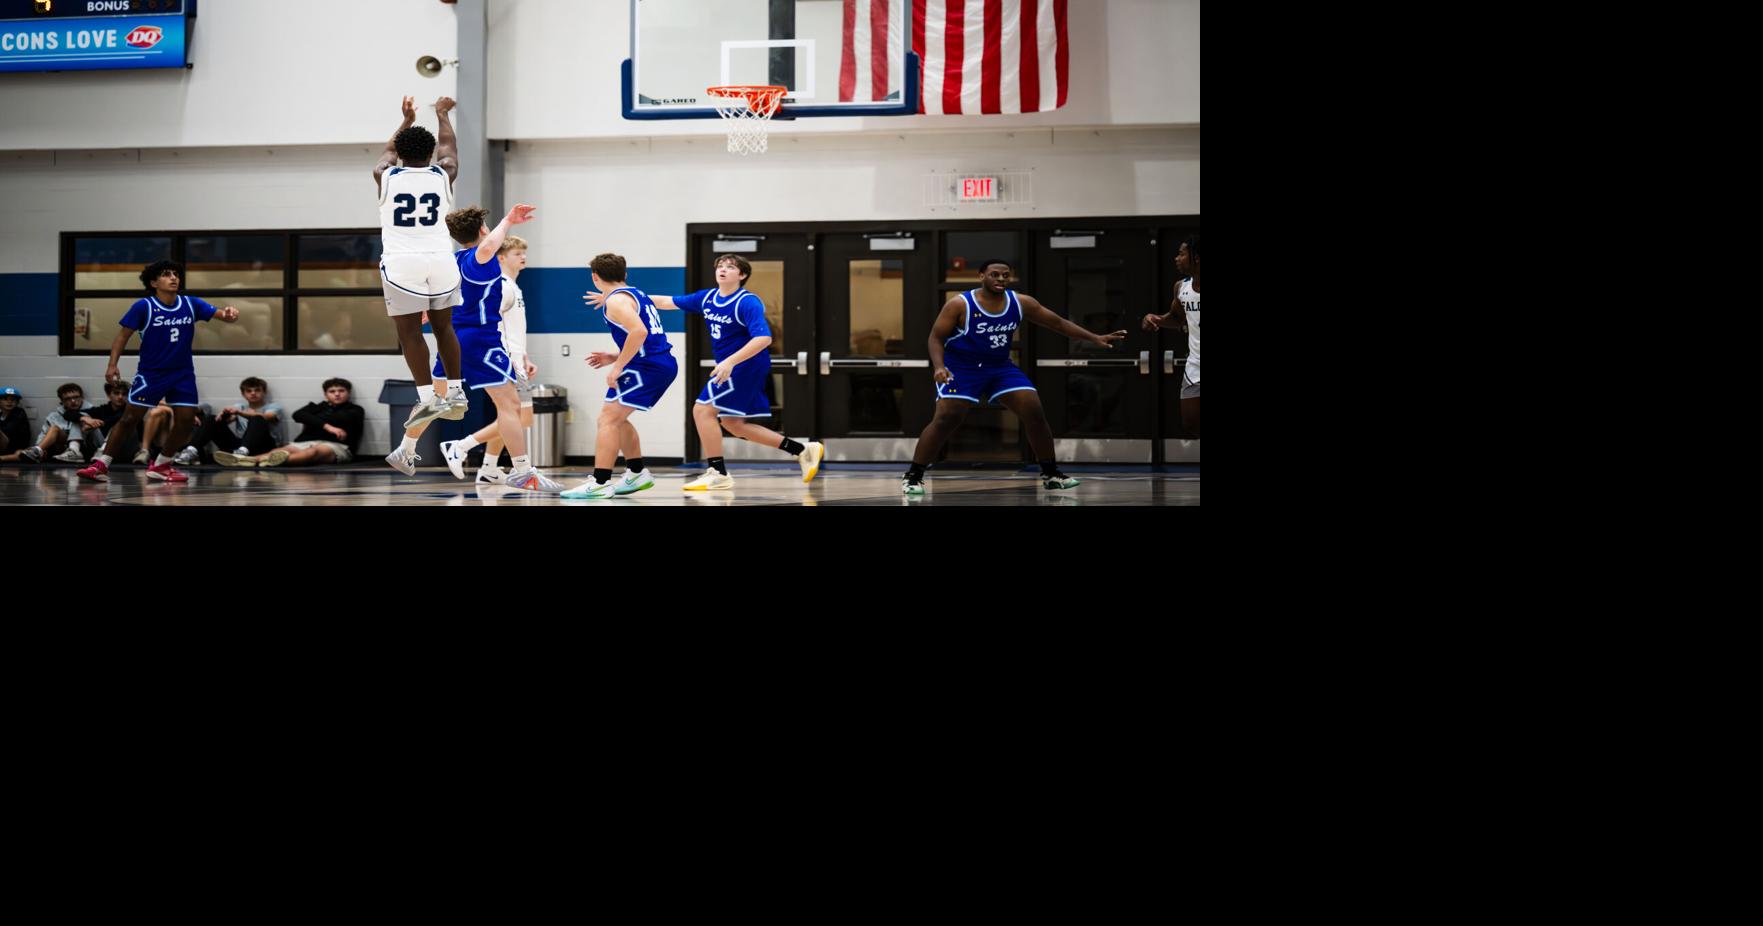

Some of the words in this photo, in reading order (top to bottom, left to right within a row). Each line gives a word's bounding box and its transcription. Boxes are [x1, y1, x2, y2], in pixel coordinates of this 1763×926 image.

[87, 1, 130, 12] BONUS
[1, 31, 59, 51] CONS
[66, 29, 118, 49] LOVE
[132, 31, 157, 44] DQ
[963, 178, 992, 199] EXIT
[393, 193, 440, 227] 23
[153, 315, 192, 327] Saints
[703, 308, 733, 324] Saints
[170, 328, 180, 342] 2
[710, 323, 721, 339] 15
[976, 322, 1017, 334] Saints
[989, 334, 1008, 349] 33
